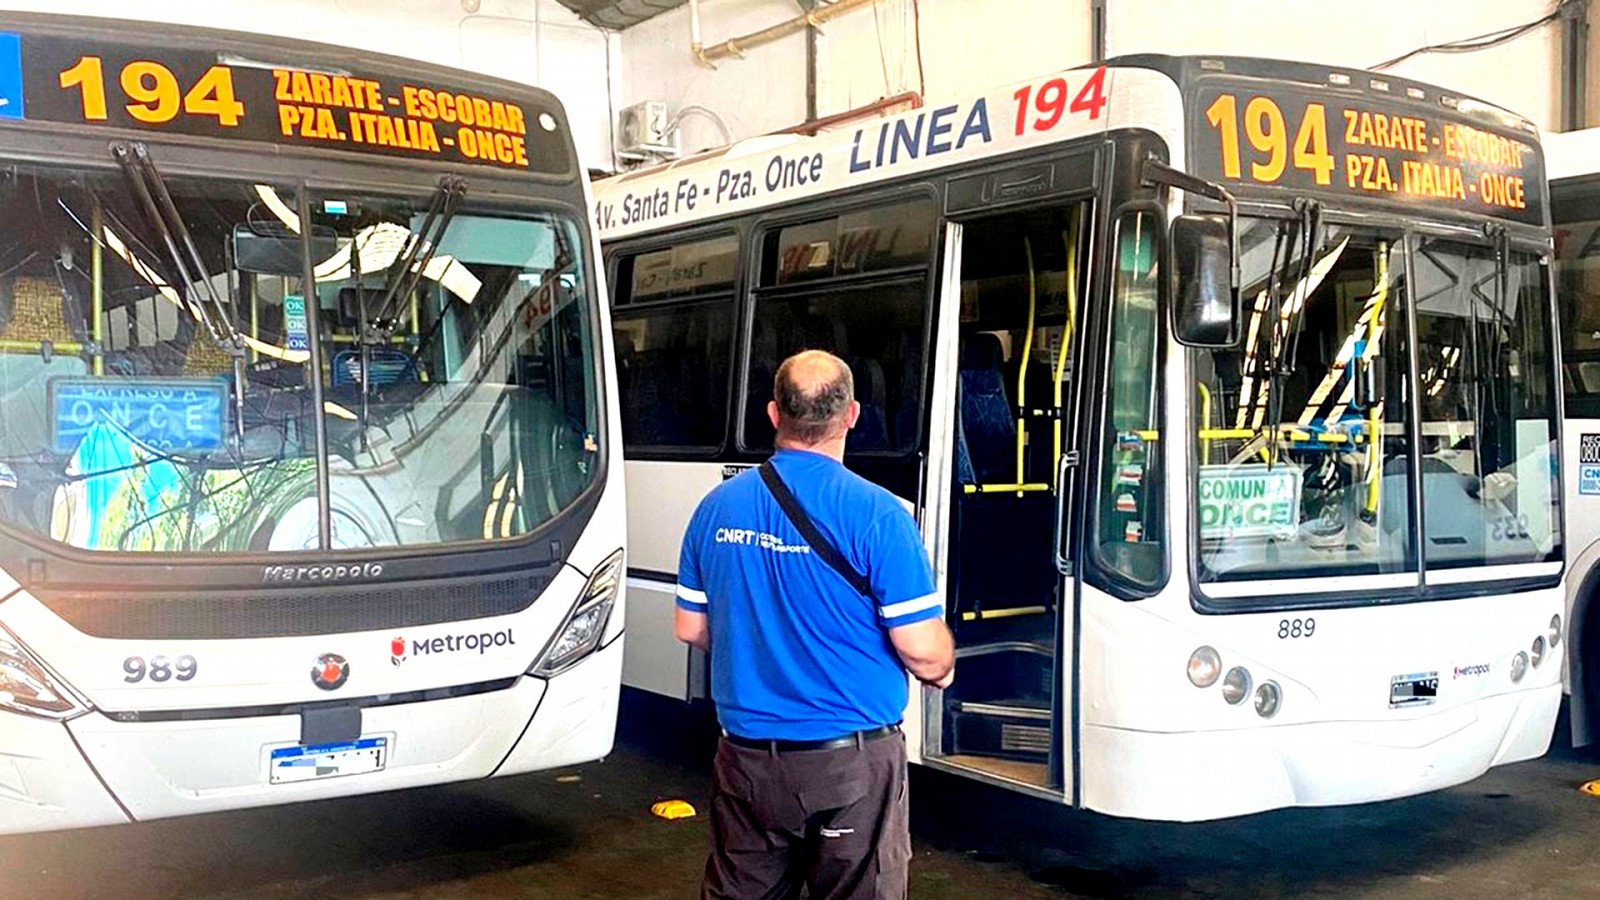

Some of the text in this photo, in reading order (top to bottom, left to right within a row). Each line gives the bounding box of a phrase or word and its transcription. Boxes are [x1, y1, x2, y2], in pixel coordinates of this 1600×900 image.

[59, 56, 245, 127] 194
[272, 68, 384, 112] ZARATE
[402, 86, 526, 135] ESCOBAR
[849, 65, 1107, 174] LINEA 194
[279, 103, 346, 141] PZA.
[350, 111, 440, 152] ITALIA
[458, 127, 529, 167] ONCE
[1205, 94, 1335, 186] 194
[1344, 109, 1428, 153] ZARATE
[1443, 122, 1523, 169] ESCOBAR
[622, 187, 670, 226] Santa
[675, 178, 698, 213] Fe
[716, 168, 757, 204] Pza.
[765, 152, 823, 192] Once
[1347, 154, 1398, 193] PZA.
[1401, 160, 1466, 200] ITALIA
[1480, 171, 1526, 209] ONCE
[286, 301, 304, 310] OK
[290, 339, 308, 349] OK
[1200, 479, 1266, 499] COMUN
[1200, 502, 1289, 527] ONCE
[715, 527, 756, 545] CNRT
[262, 563, 383, 582] Marcopolo
[412, 628, 515, 656] Metropol
[1277, 617, 1316, 639] 889
[122, 655, 198, 684] 989
